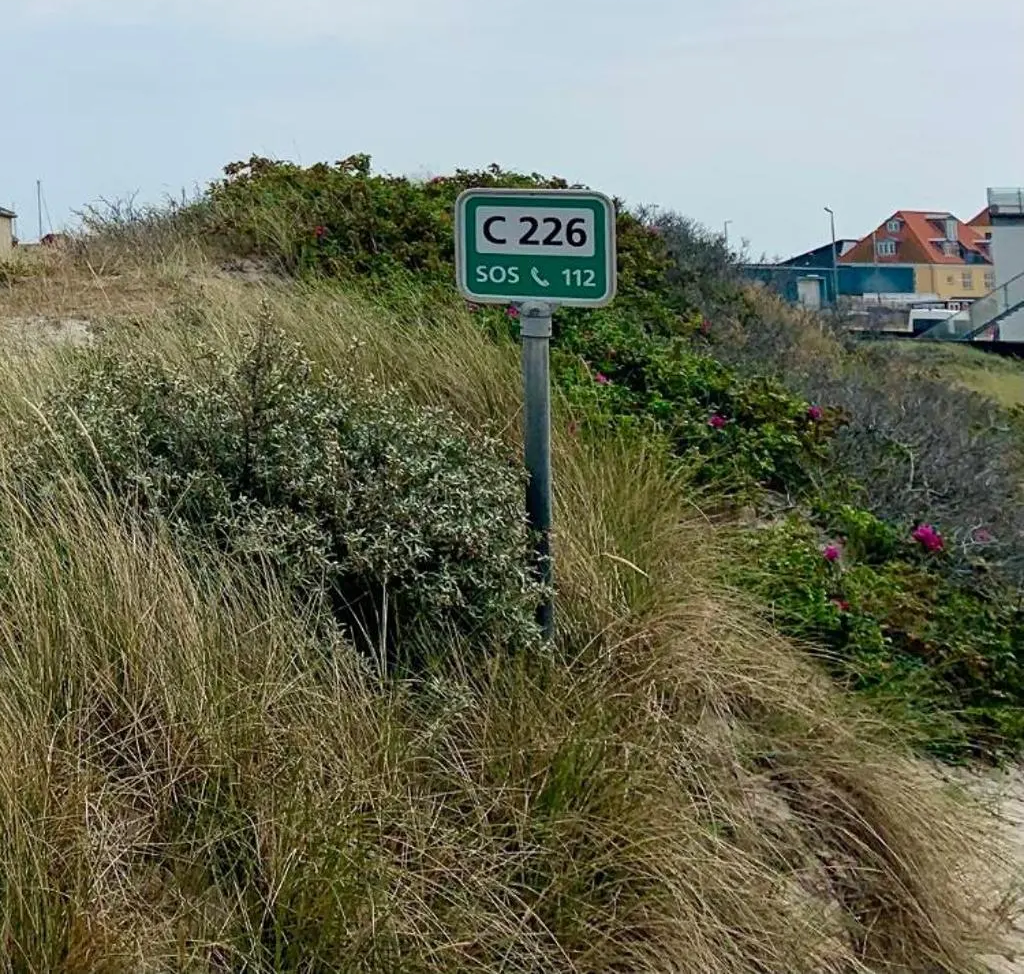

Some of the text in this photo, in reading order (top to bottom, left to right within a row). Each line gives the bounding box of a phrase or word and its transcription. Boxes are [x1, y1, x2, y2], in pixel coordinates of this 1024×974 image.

[483, 215, 588, 248] C 226
[475, 265, 597, 287] SOS 112
